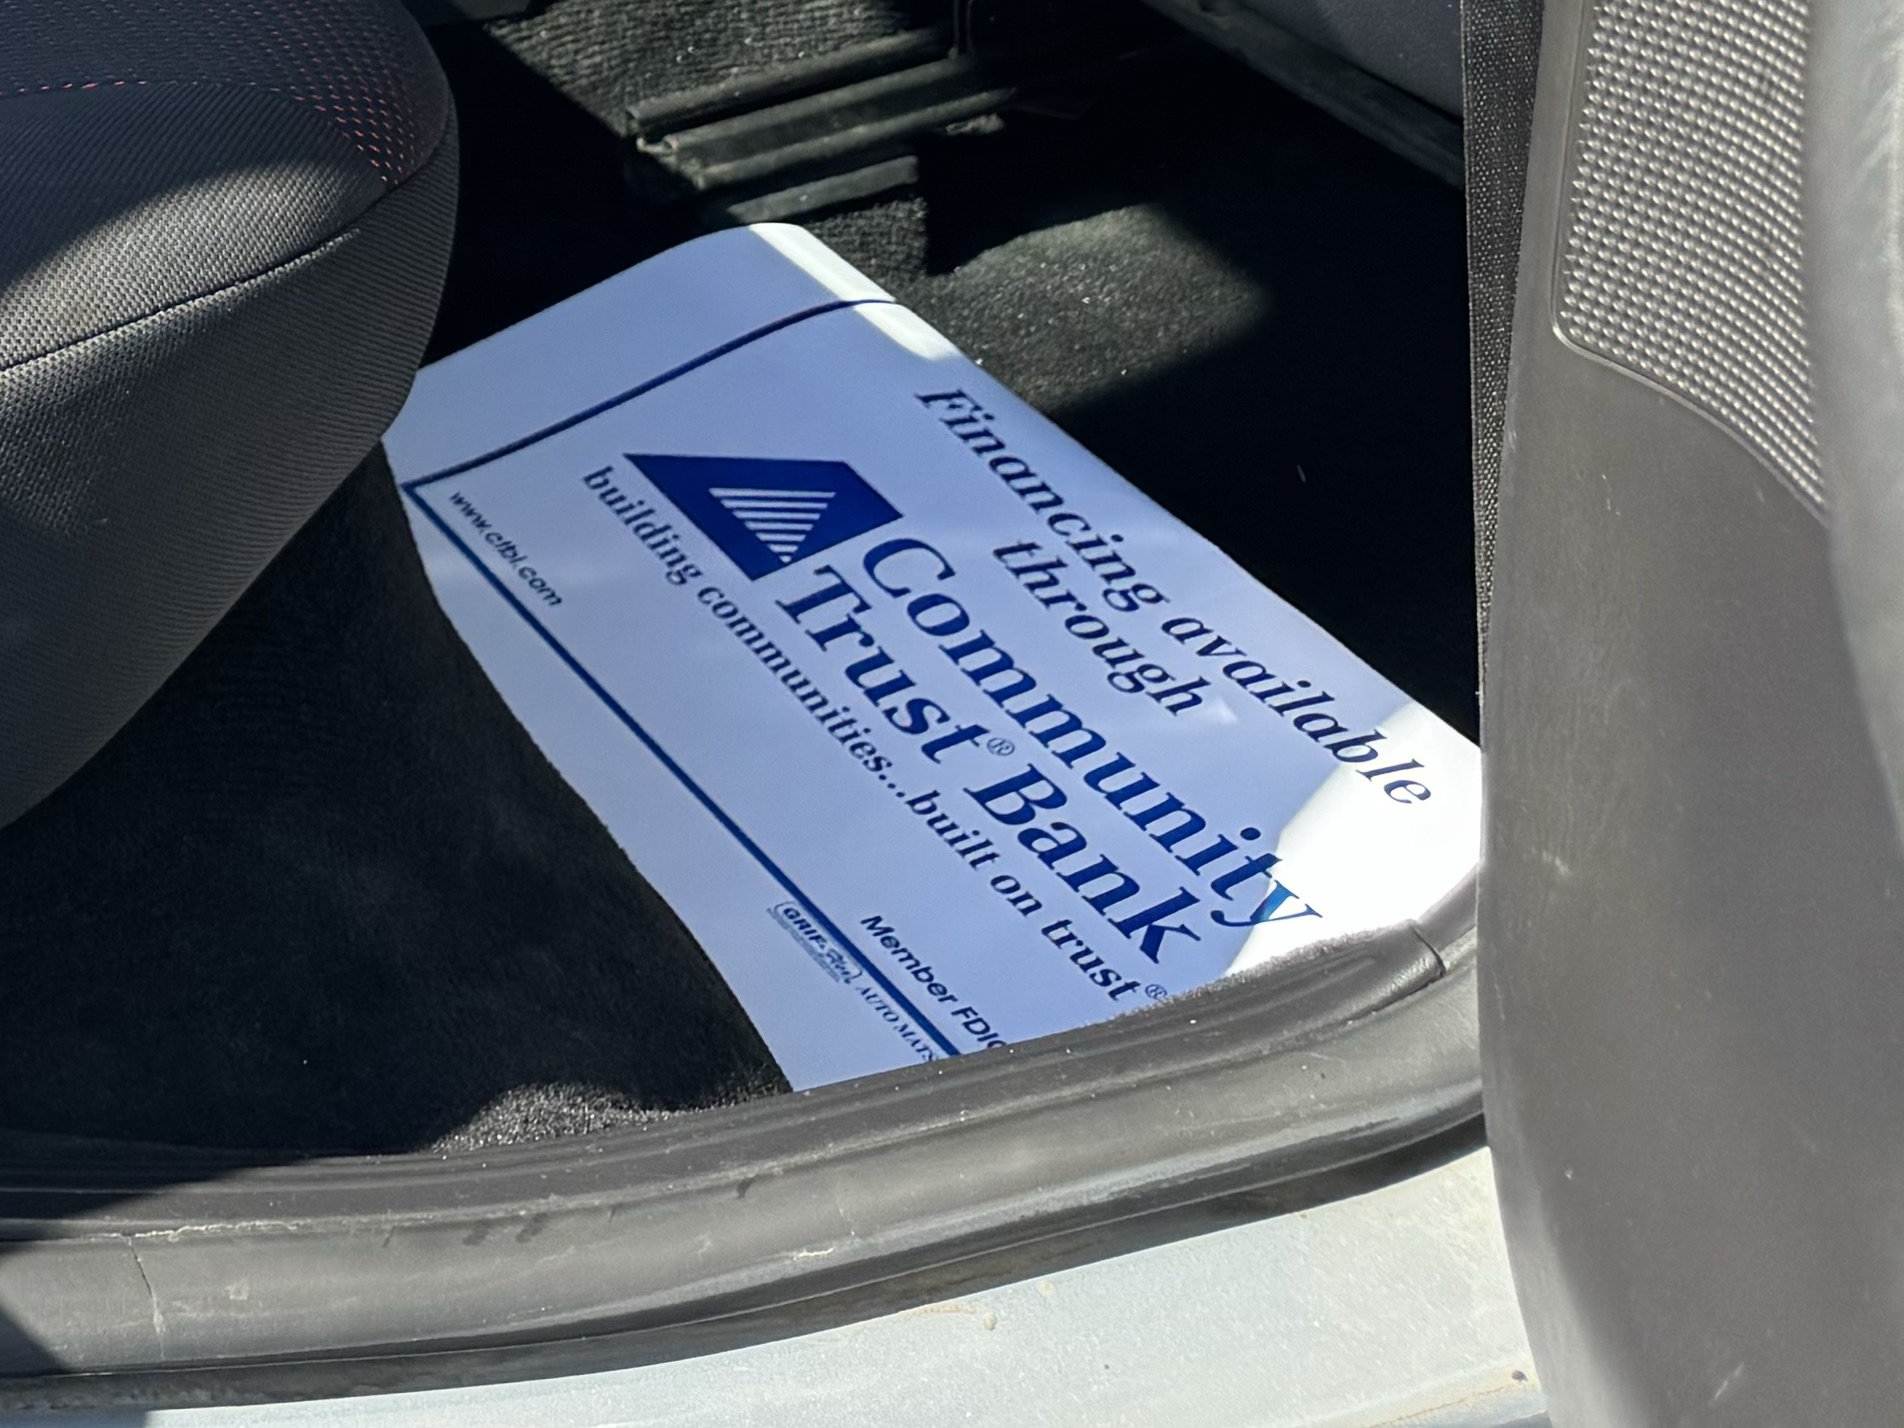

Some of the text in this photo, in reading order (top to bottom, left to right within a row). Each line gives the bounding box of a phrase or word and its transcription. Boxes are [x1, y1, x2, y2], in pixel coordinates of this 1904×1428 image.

[582, 465, 703, 586] building
[990, 874, 1043, 918] on
[862, 537, 1324, 928] Community
[914, 388, 1432, 805] Financing available
[992, 540, 1211, 717] through
[860, 915, 958, 1004] Member
[963, 762, 1202, 965] Bank
